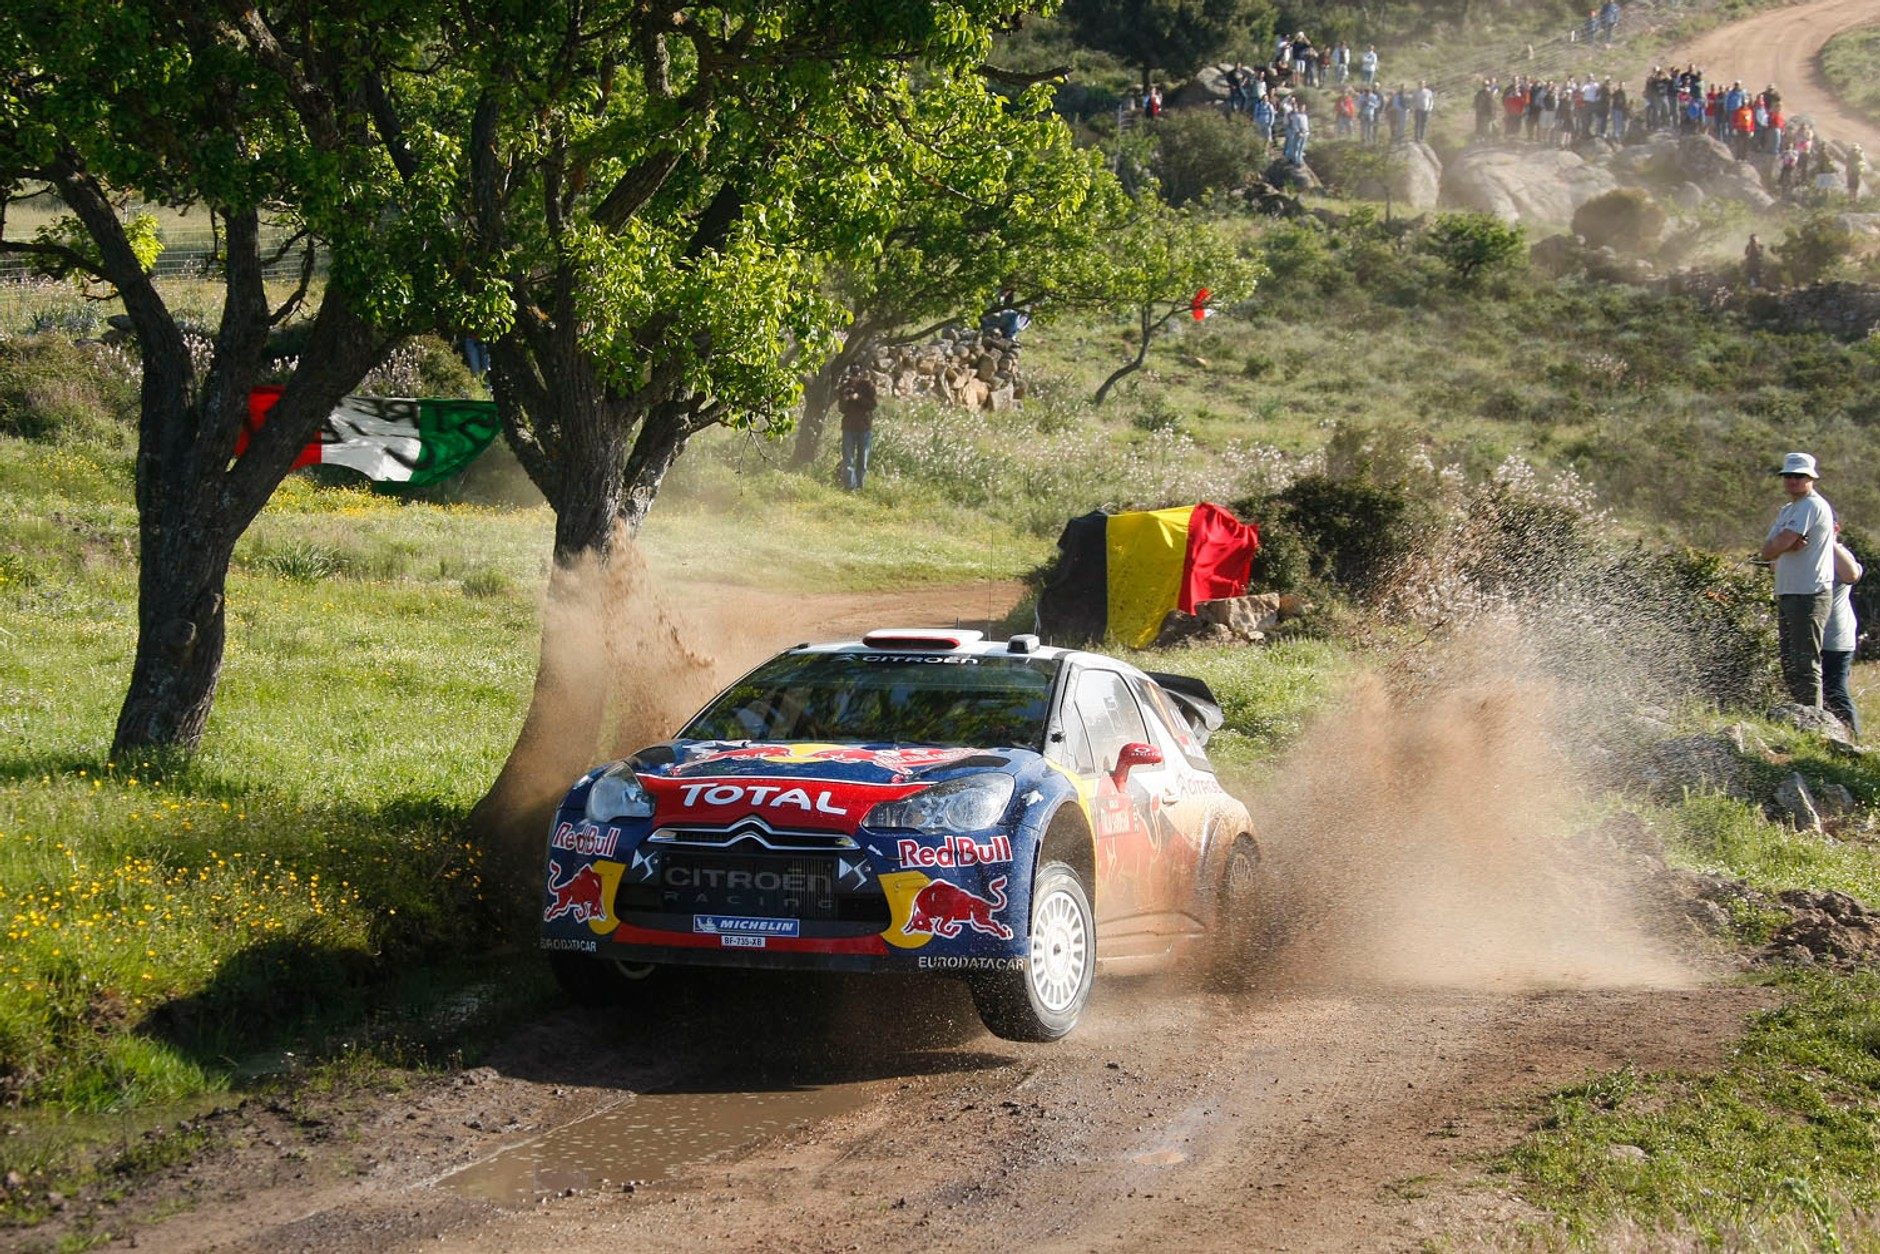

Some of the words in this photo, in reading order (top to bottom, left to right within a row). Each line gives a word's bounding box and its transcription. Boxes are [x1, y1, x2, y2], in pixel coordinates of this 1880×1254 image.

[680, 783, 847, 815] TOTAL
[720, 919, 794, 932] MICHELIN
[918, 956, 1025, 970] EURODATACAR
